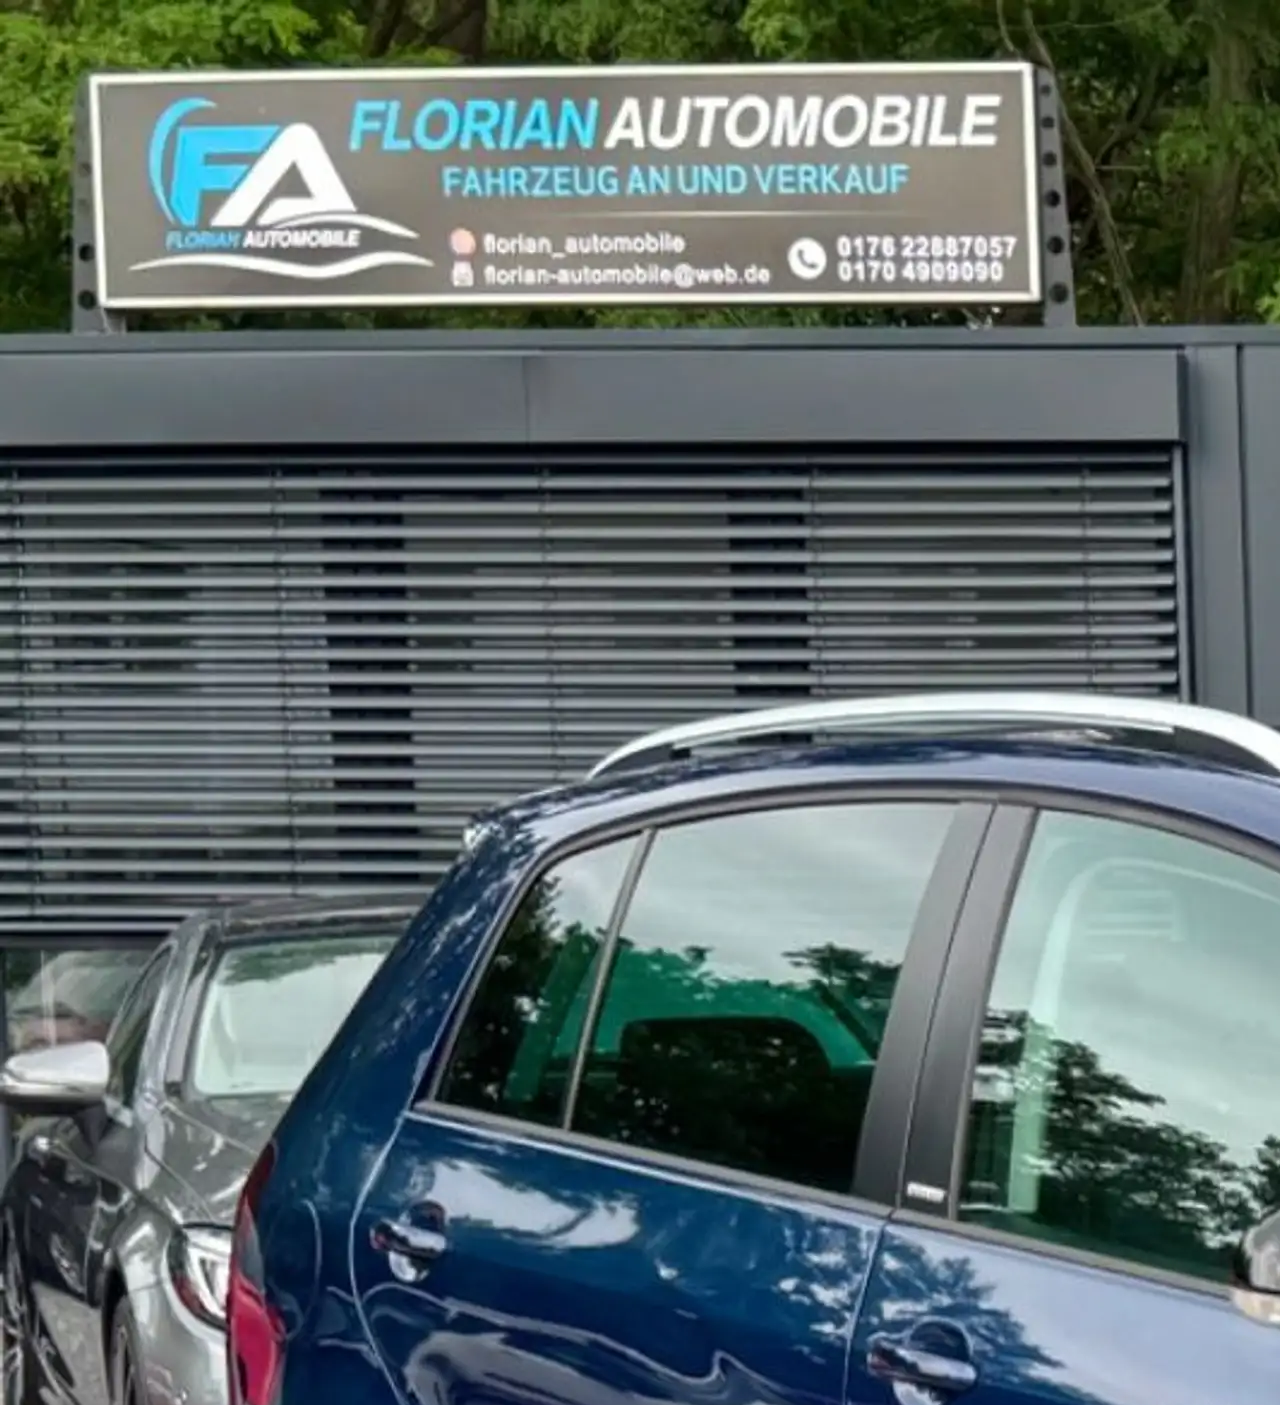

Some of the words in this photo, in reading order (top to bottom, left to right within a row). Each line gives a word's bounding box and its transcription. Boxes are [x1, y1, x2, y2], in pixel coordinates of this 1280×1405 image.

[348, 97, 598, 152] FLORIAN
[604, 94, 1002, 149] AUTOMOBILE
[442, 164, 620, 198] FAHRZEUG
[626, 164, 674, 196] AN
[677, 164, 748, 195] UND
[757, 163, 911, 195] VERKAUF
[243, 229, 362, 249] AUTOMOBILE
[836, 234, 896, 258] 0176
[837, 260, 896, 282] 0170
